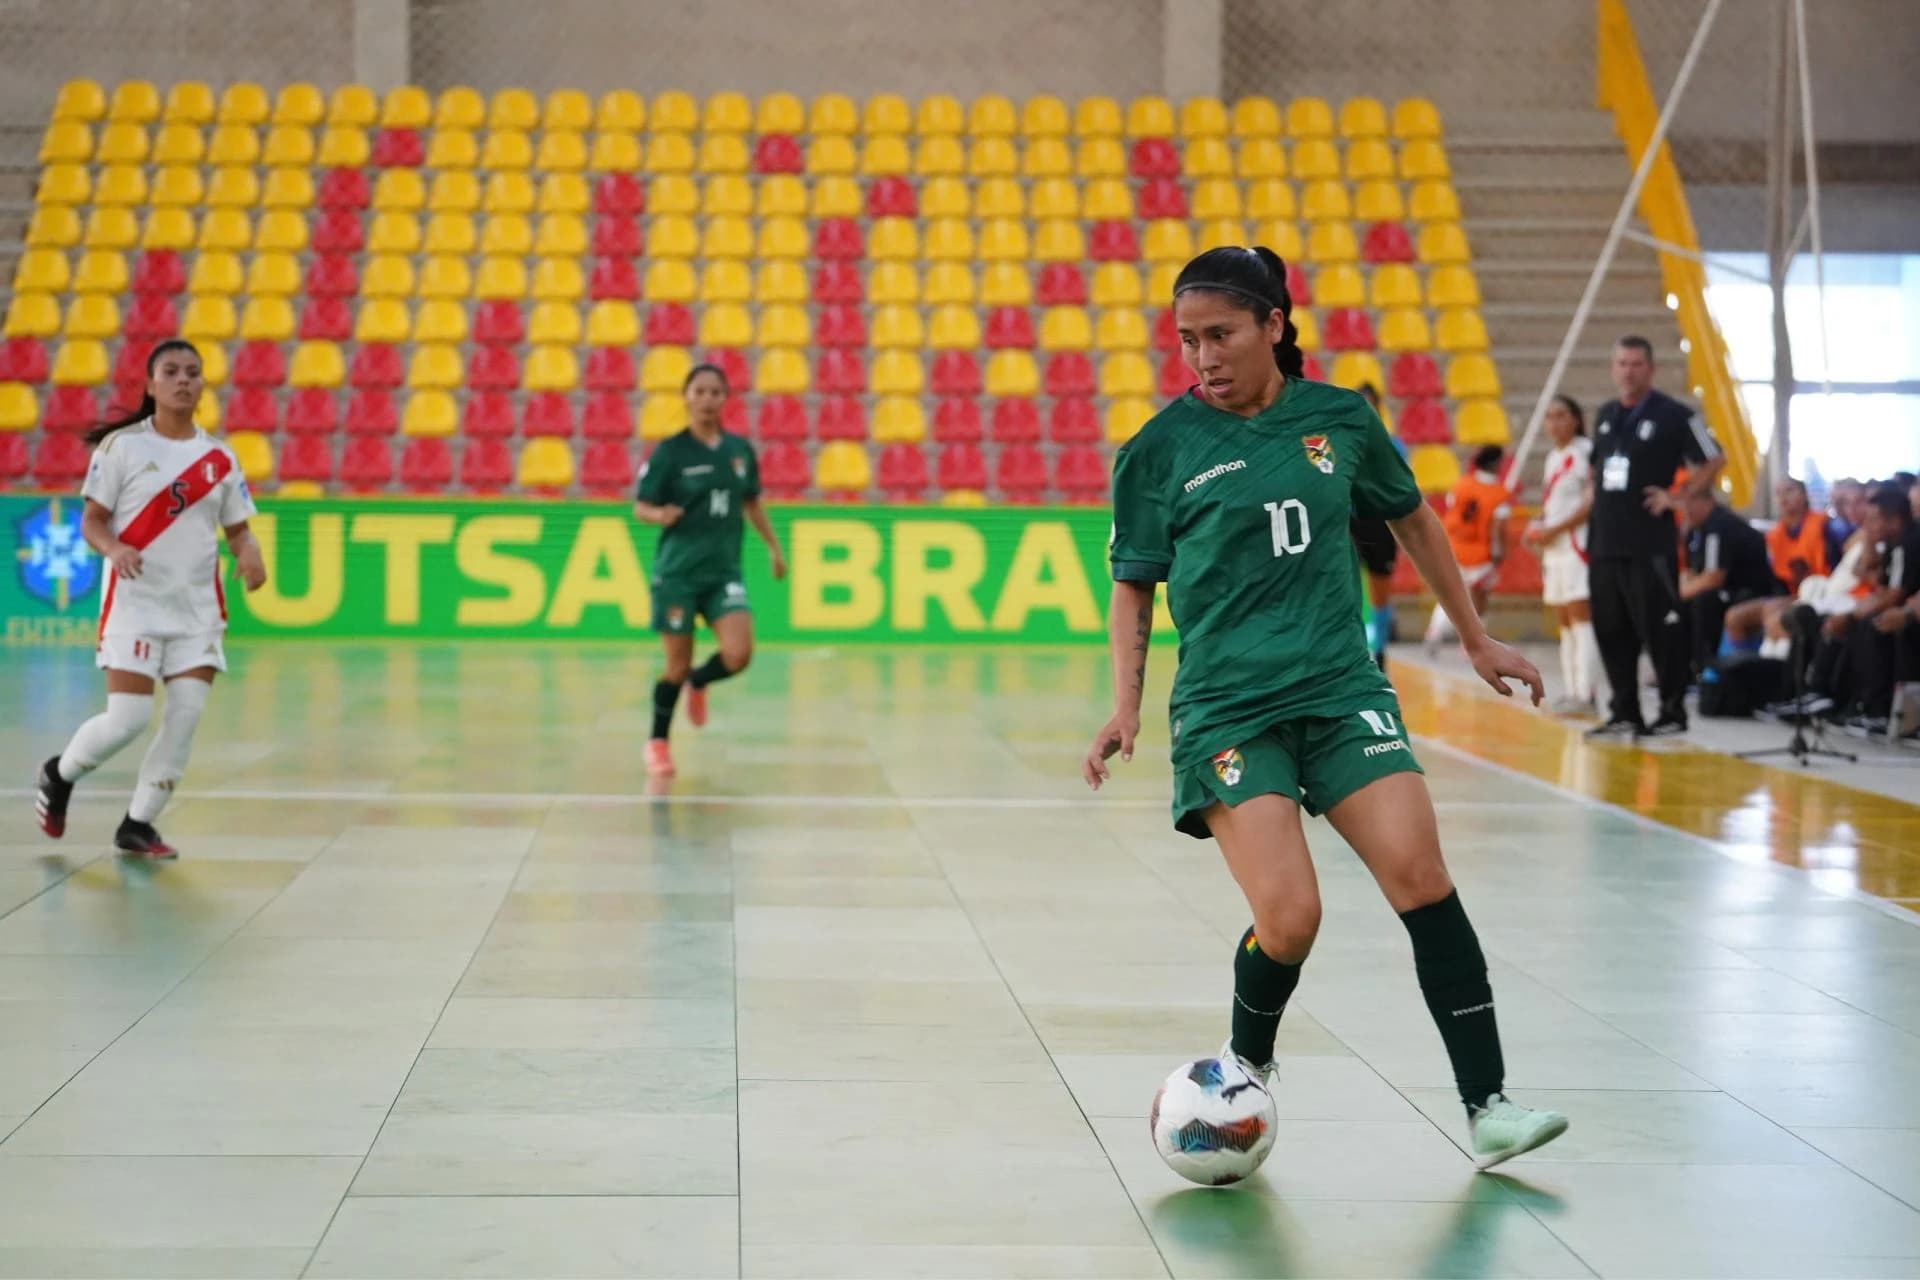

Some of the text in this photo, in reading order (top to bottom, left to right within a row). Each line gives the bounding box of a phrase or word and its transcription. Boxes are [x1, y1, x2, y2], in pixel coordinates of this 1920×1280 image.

[169, 482, 189, 514] 5
[1183, 459, 1247, 493] marathon
[1263, 498, 1311, 558] 10
[217, 511, 1184, 633] UTSA BRA
